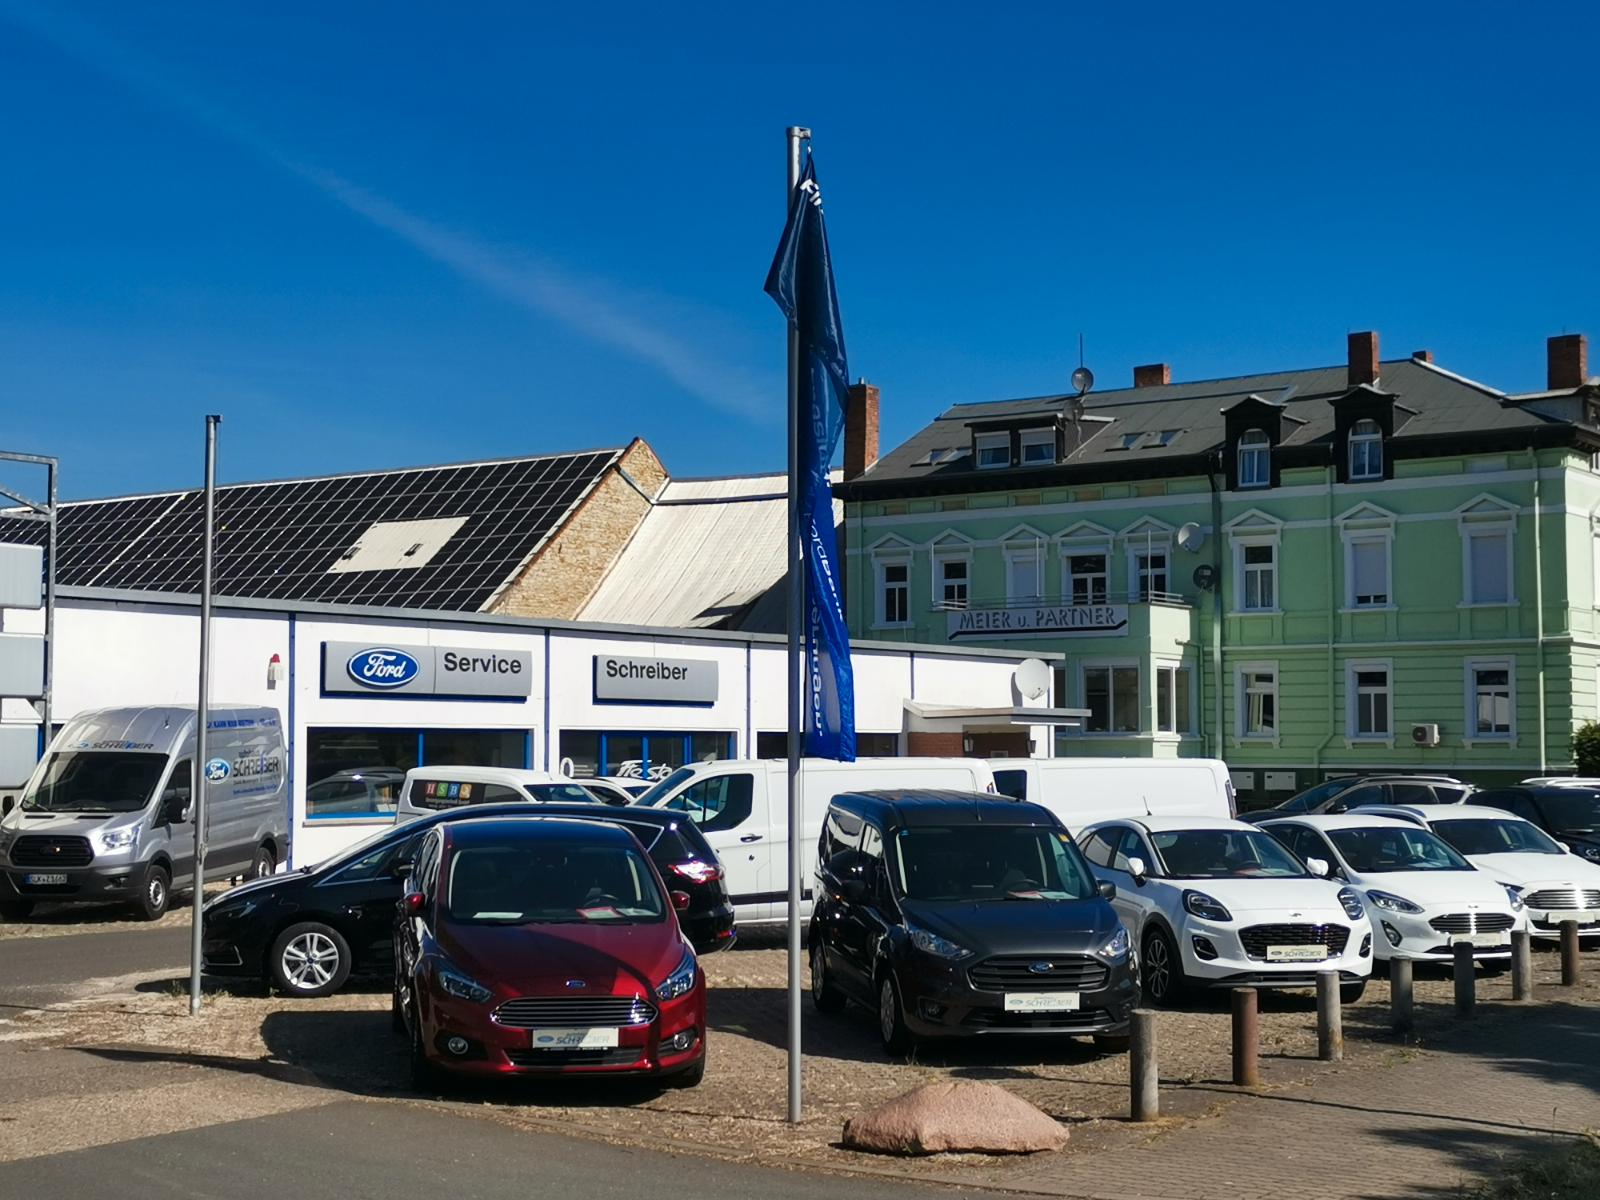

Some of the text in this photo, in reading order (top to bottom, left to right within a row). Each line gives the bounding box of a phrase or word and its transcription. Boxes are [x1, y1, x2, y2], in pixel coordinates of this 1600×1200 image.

[960, 612, 1012, 630] MEIER
[1036, 608, 1116, 627] PARTNER
[363, 653, 407, 678] Ford
[444, 652, 522, 674] Service
[606, 659, 688, 680] Schreiber
